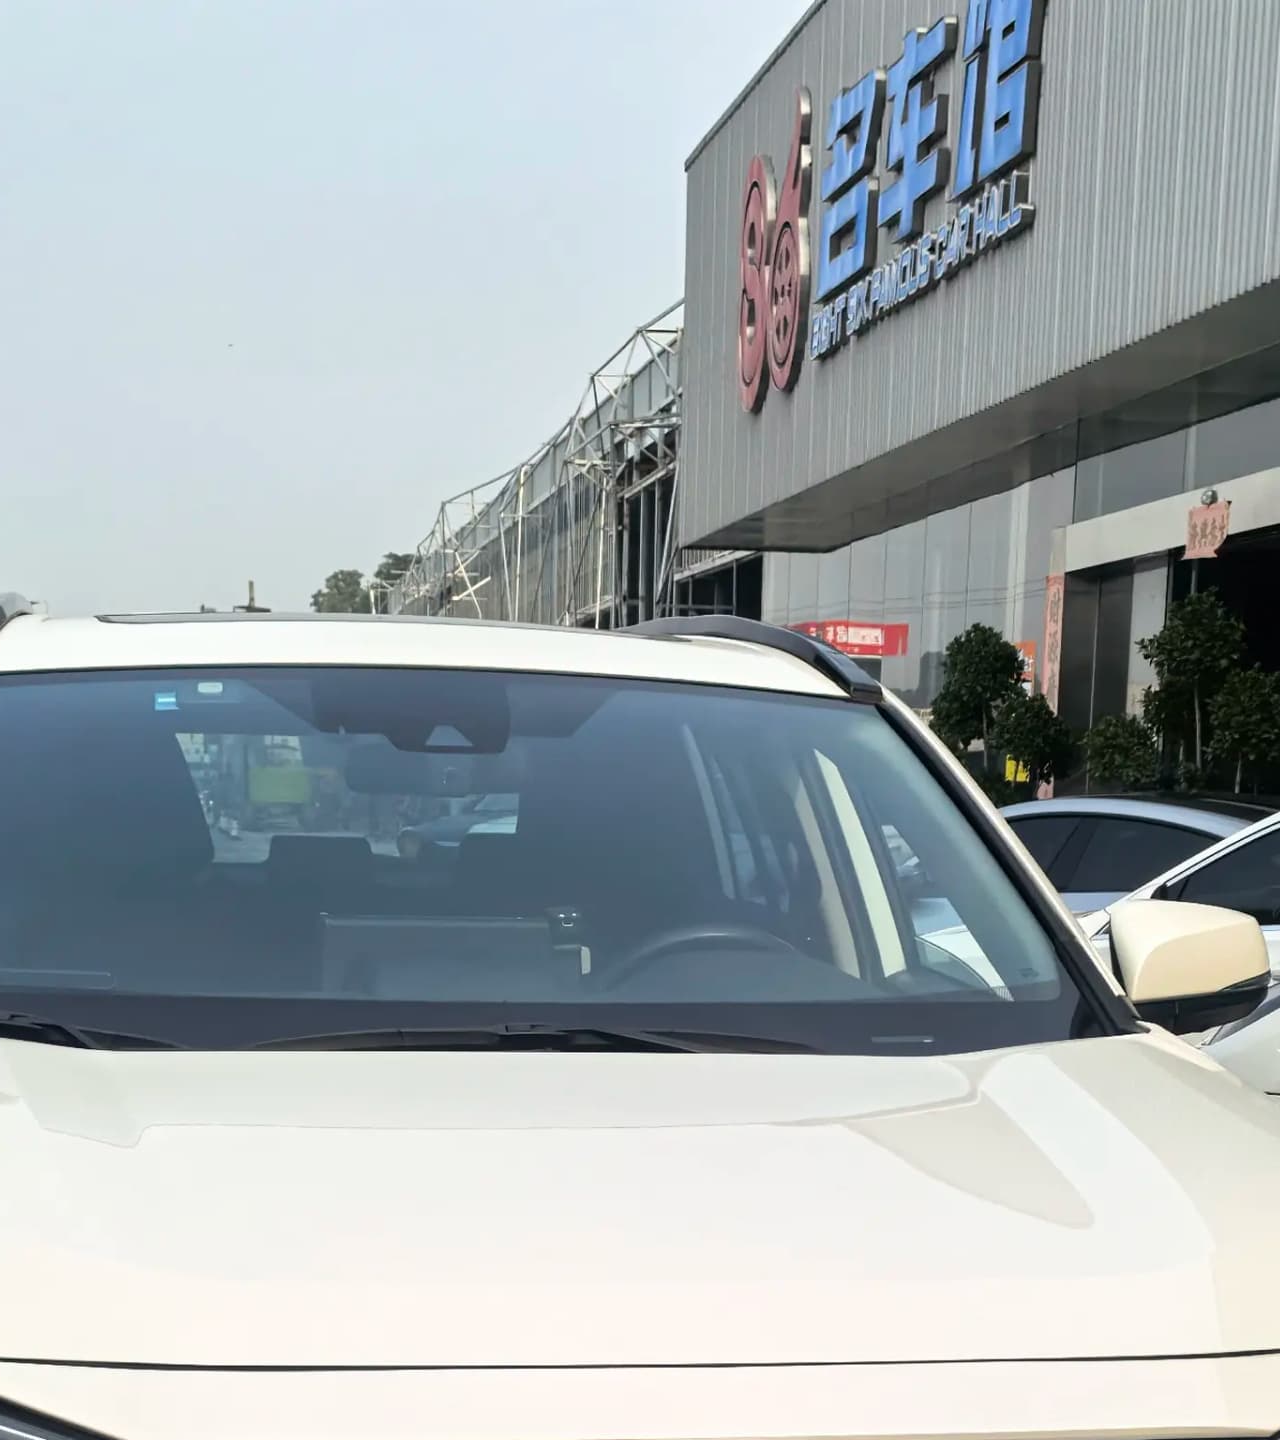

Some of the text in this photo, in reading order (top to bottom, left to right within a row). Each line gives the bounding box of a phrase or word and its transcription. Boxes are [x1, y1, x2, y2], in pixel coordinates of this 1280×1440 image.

[810, 170, 1035, 361] EIGHT SIX FAMOUS CAR HALL
